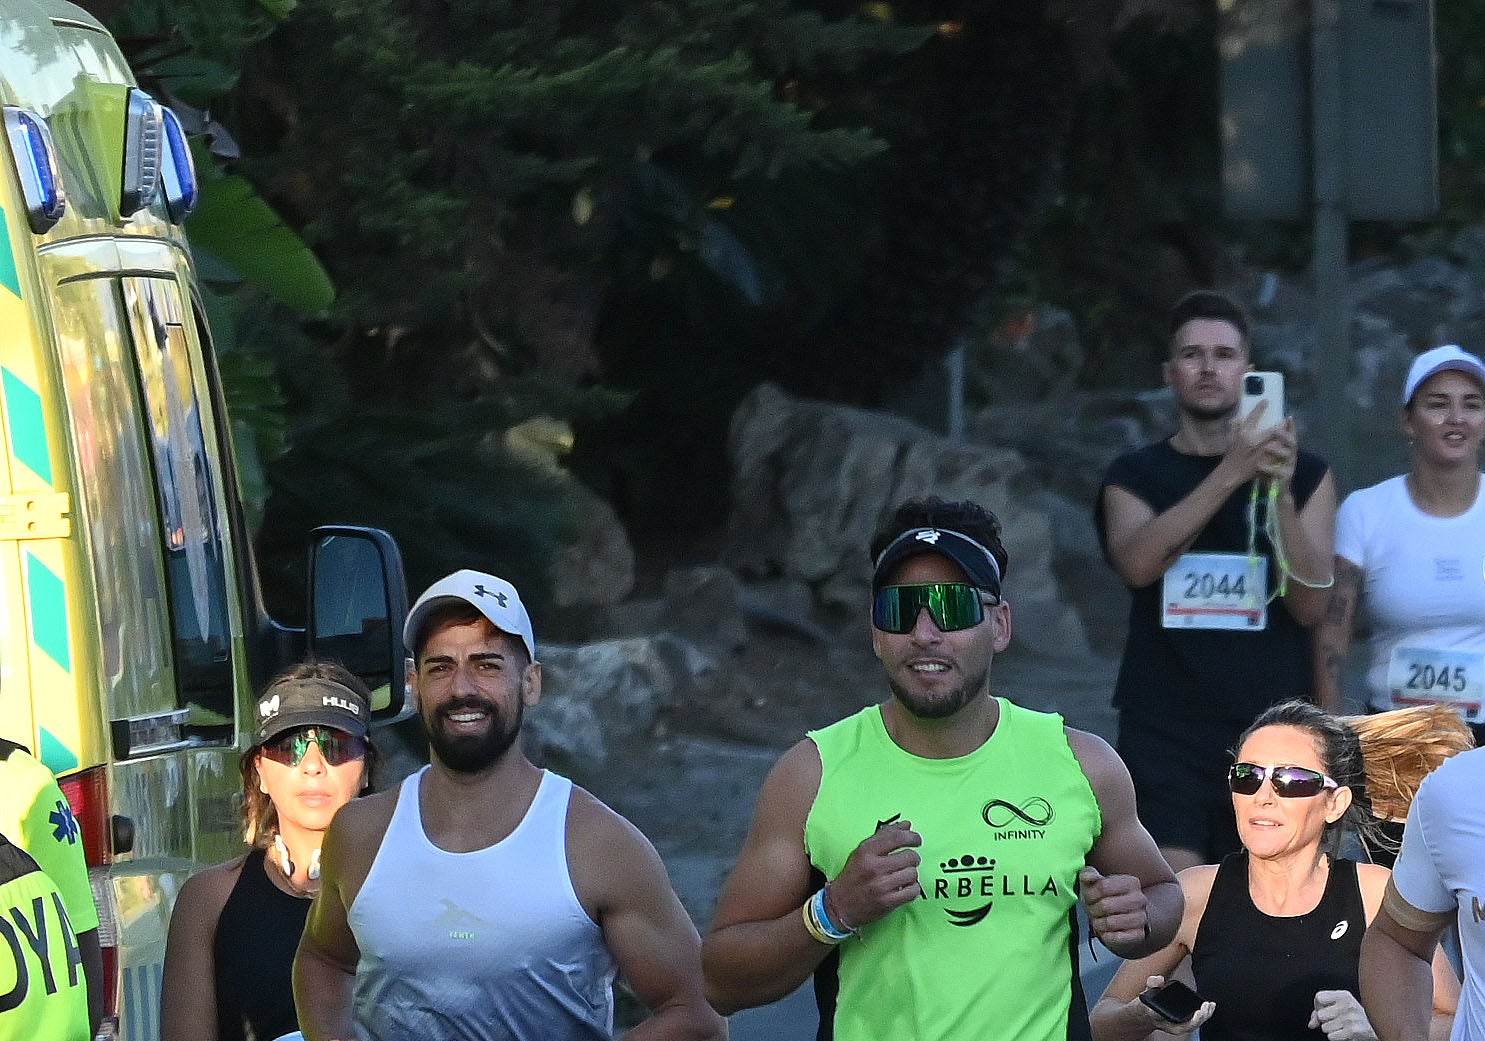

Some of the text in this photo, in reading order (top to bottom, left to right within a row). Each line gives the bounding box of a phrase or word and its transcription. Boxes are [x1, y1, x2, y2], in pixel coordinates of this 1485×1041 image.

[1183, 573, 1247, 600] 2044
[1405, 663, 1468, 693] 2045
[993, 829, 1047, 842] INFINITY
[916, 874, 1060, 900] RBELLA
